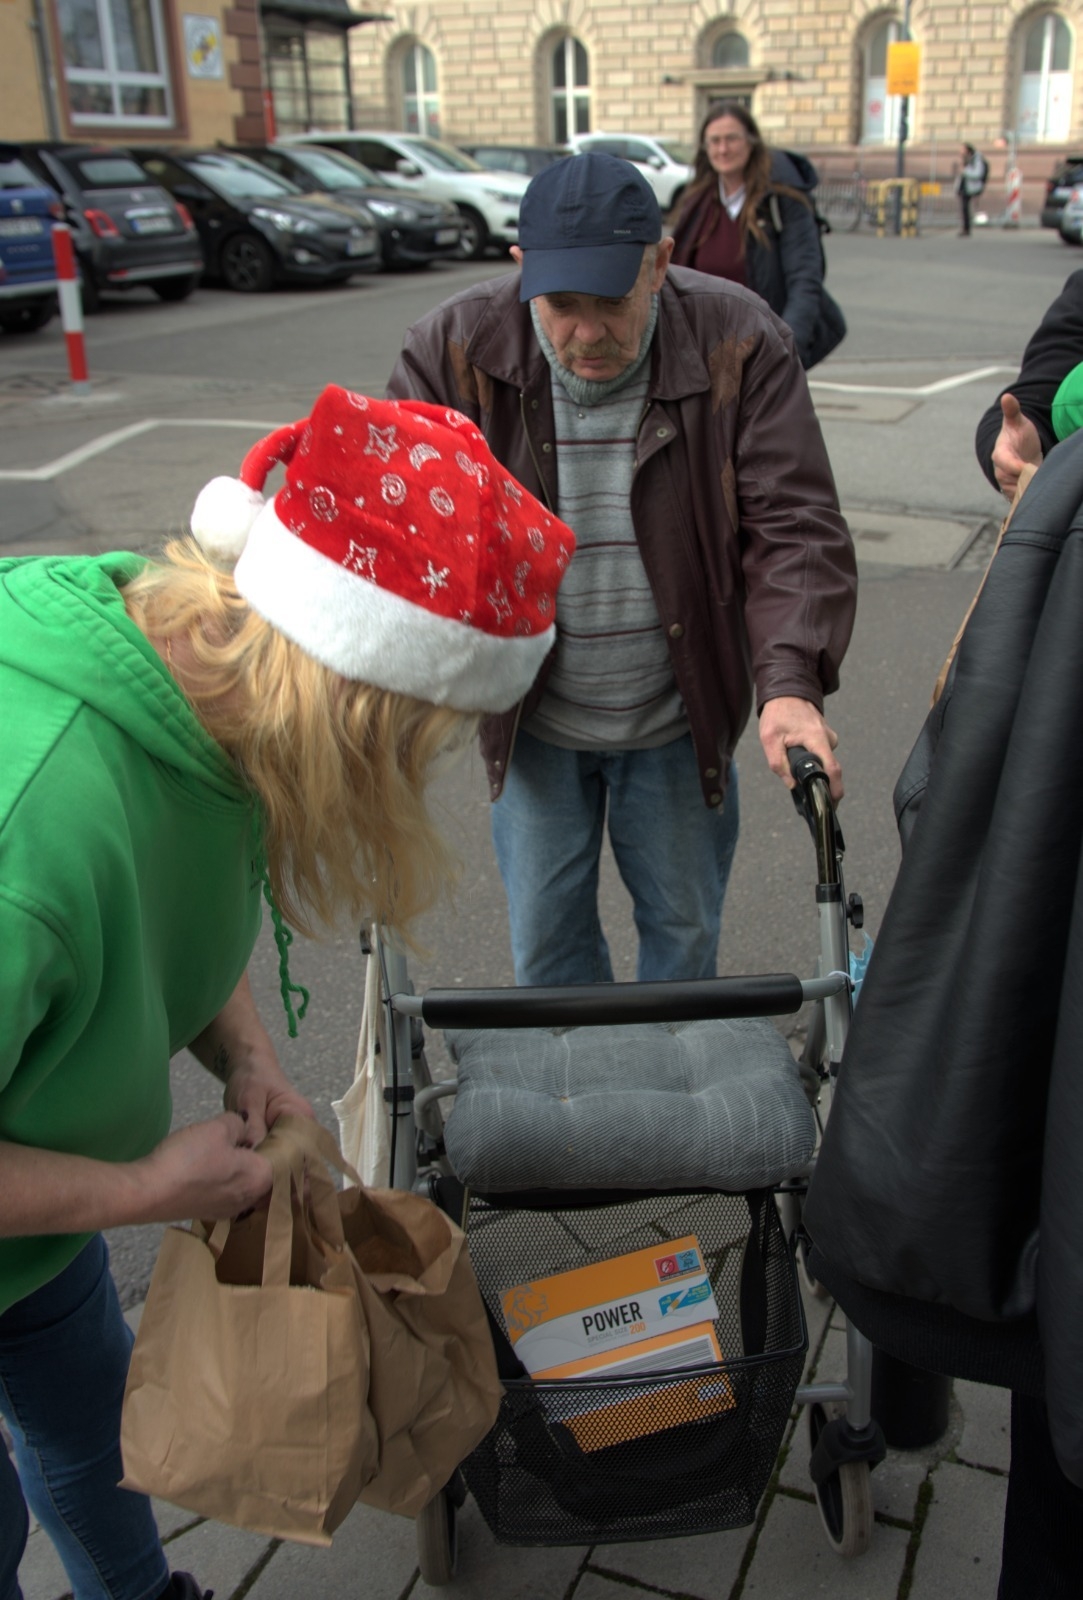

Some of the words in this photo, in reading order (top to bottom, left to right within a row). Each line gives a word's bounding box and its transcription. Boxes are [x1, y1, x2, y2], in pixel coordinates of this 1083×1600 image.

[582, 1301, 643, 1336] POWER
[587, 1331, 612, 1343] SPECIAL
[614, 1327, 628, 1336] SIZE
[629, 1321, 646, 1335] 200
